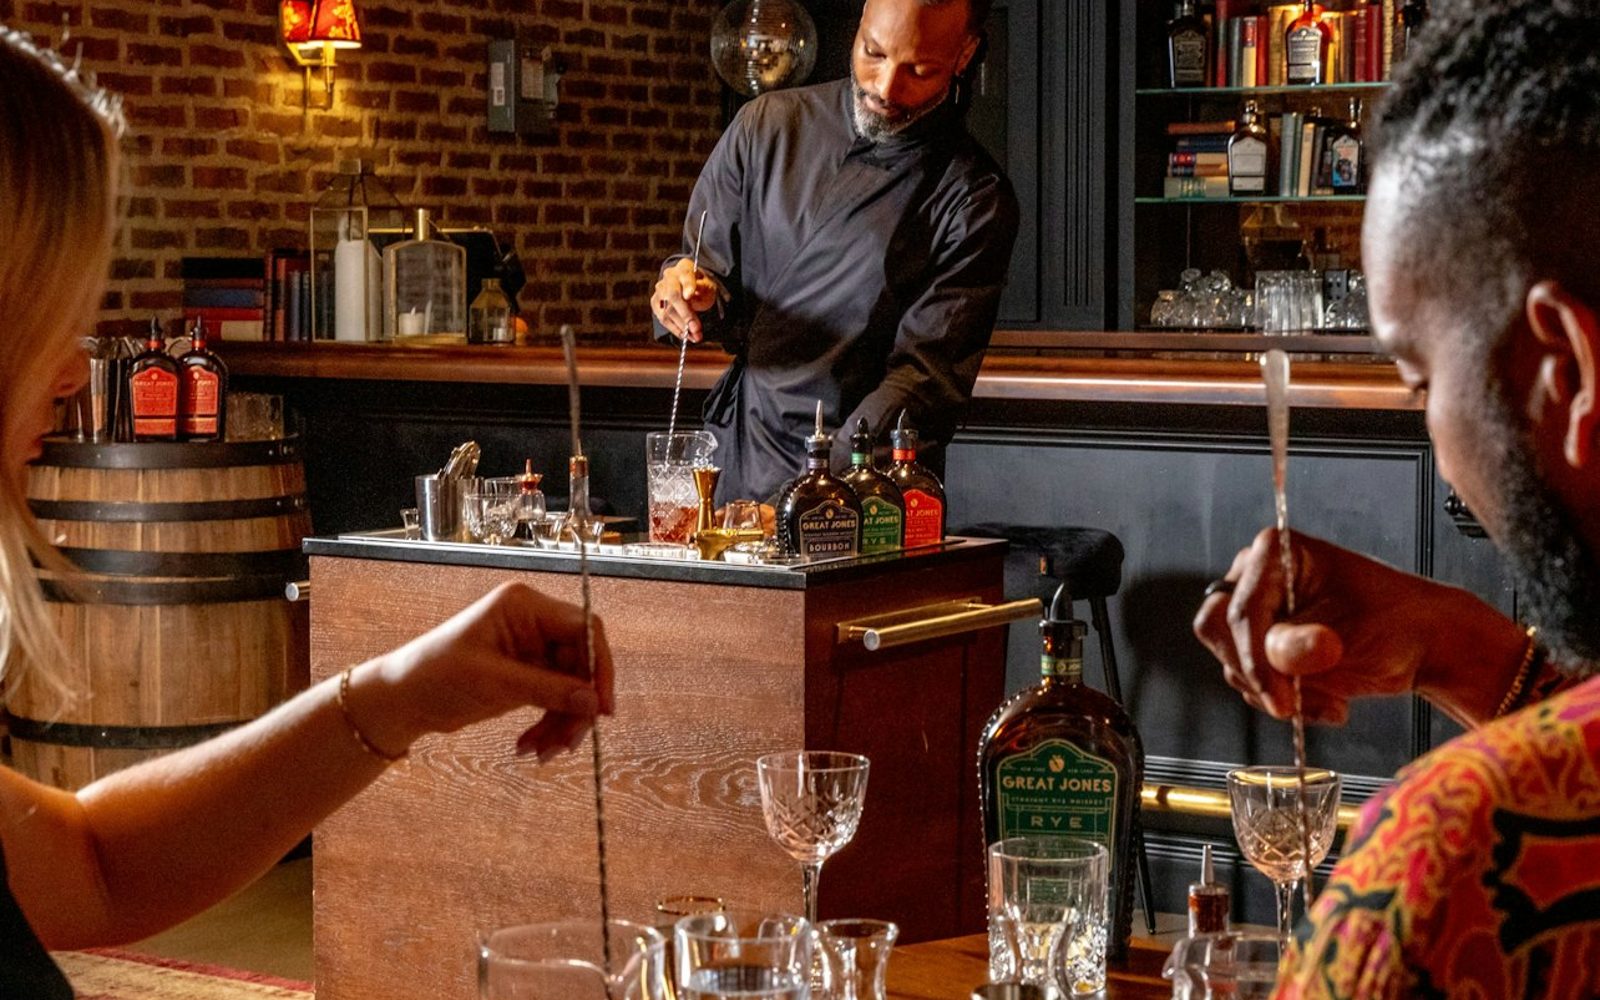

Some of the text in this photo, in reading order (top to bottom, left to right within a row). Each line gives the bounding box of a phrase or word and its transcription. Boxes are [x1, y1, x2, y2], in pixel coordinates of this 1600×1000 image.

[802, 520, 830, 531] GREAT
[830, 519, 856, 529] JONES
[809, 542, 850, 552] BOURBON
[1002, 775, 1112, 793] GREAT JONES
[1031, 815, 1083, 829] RYE
